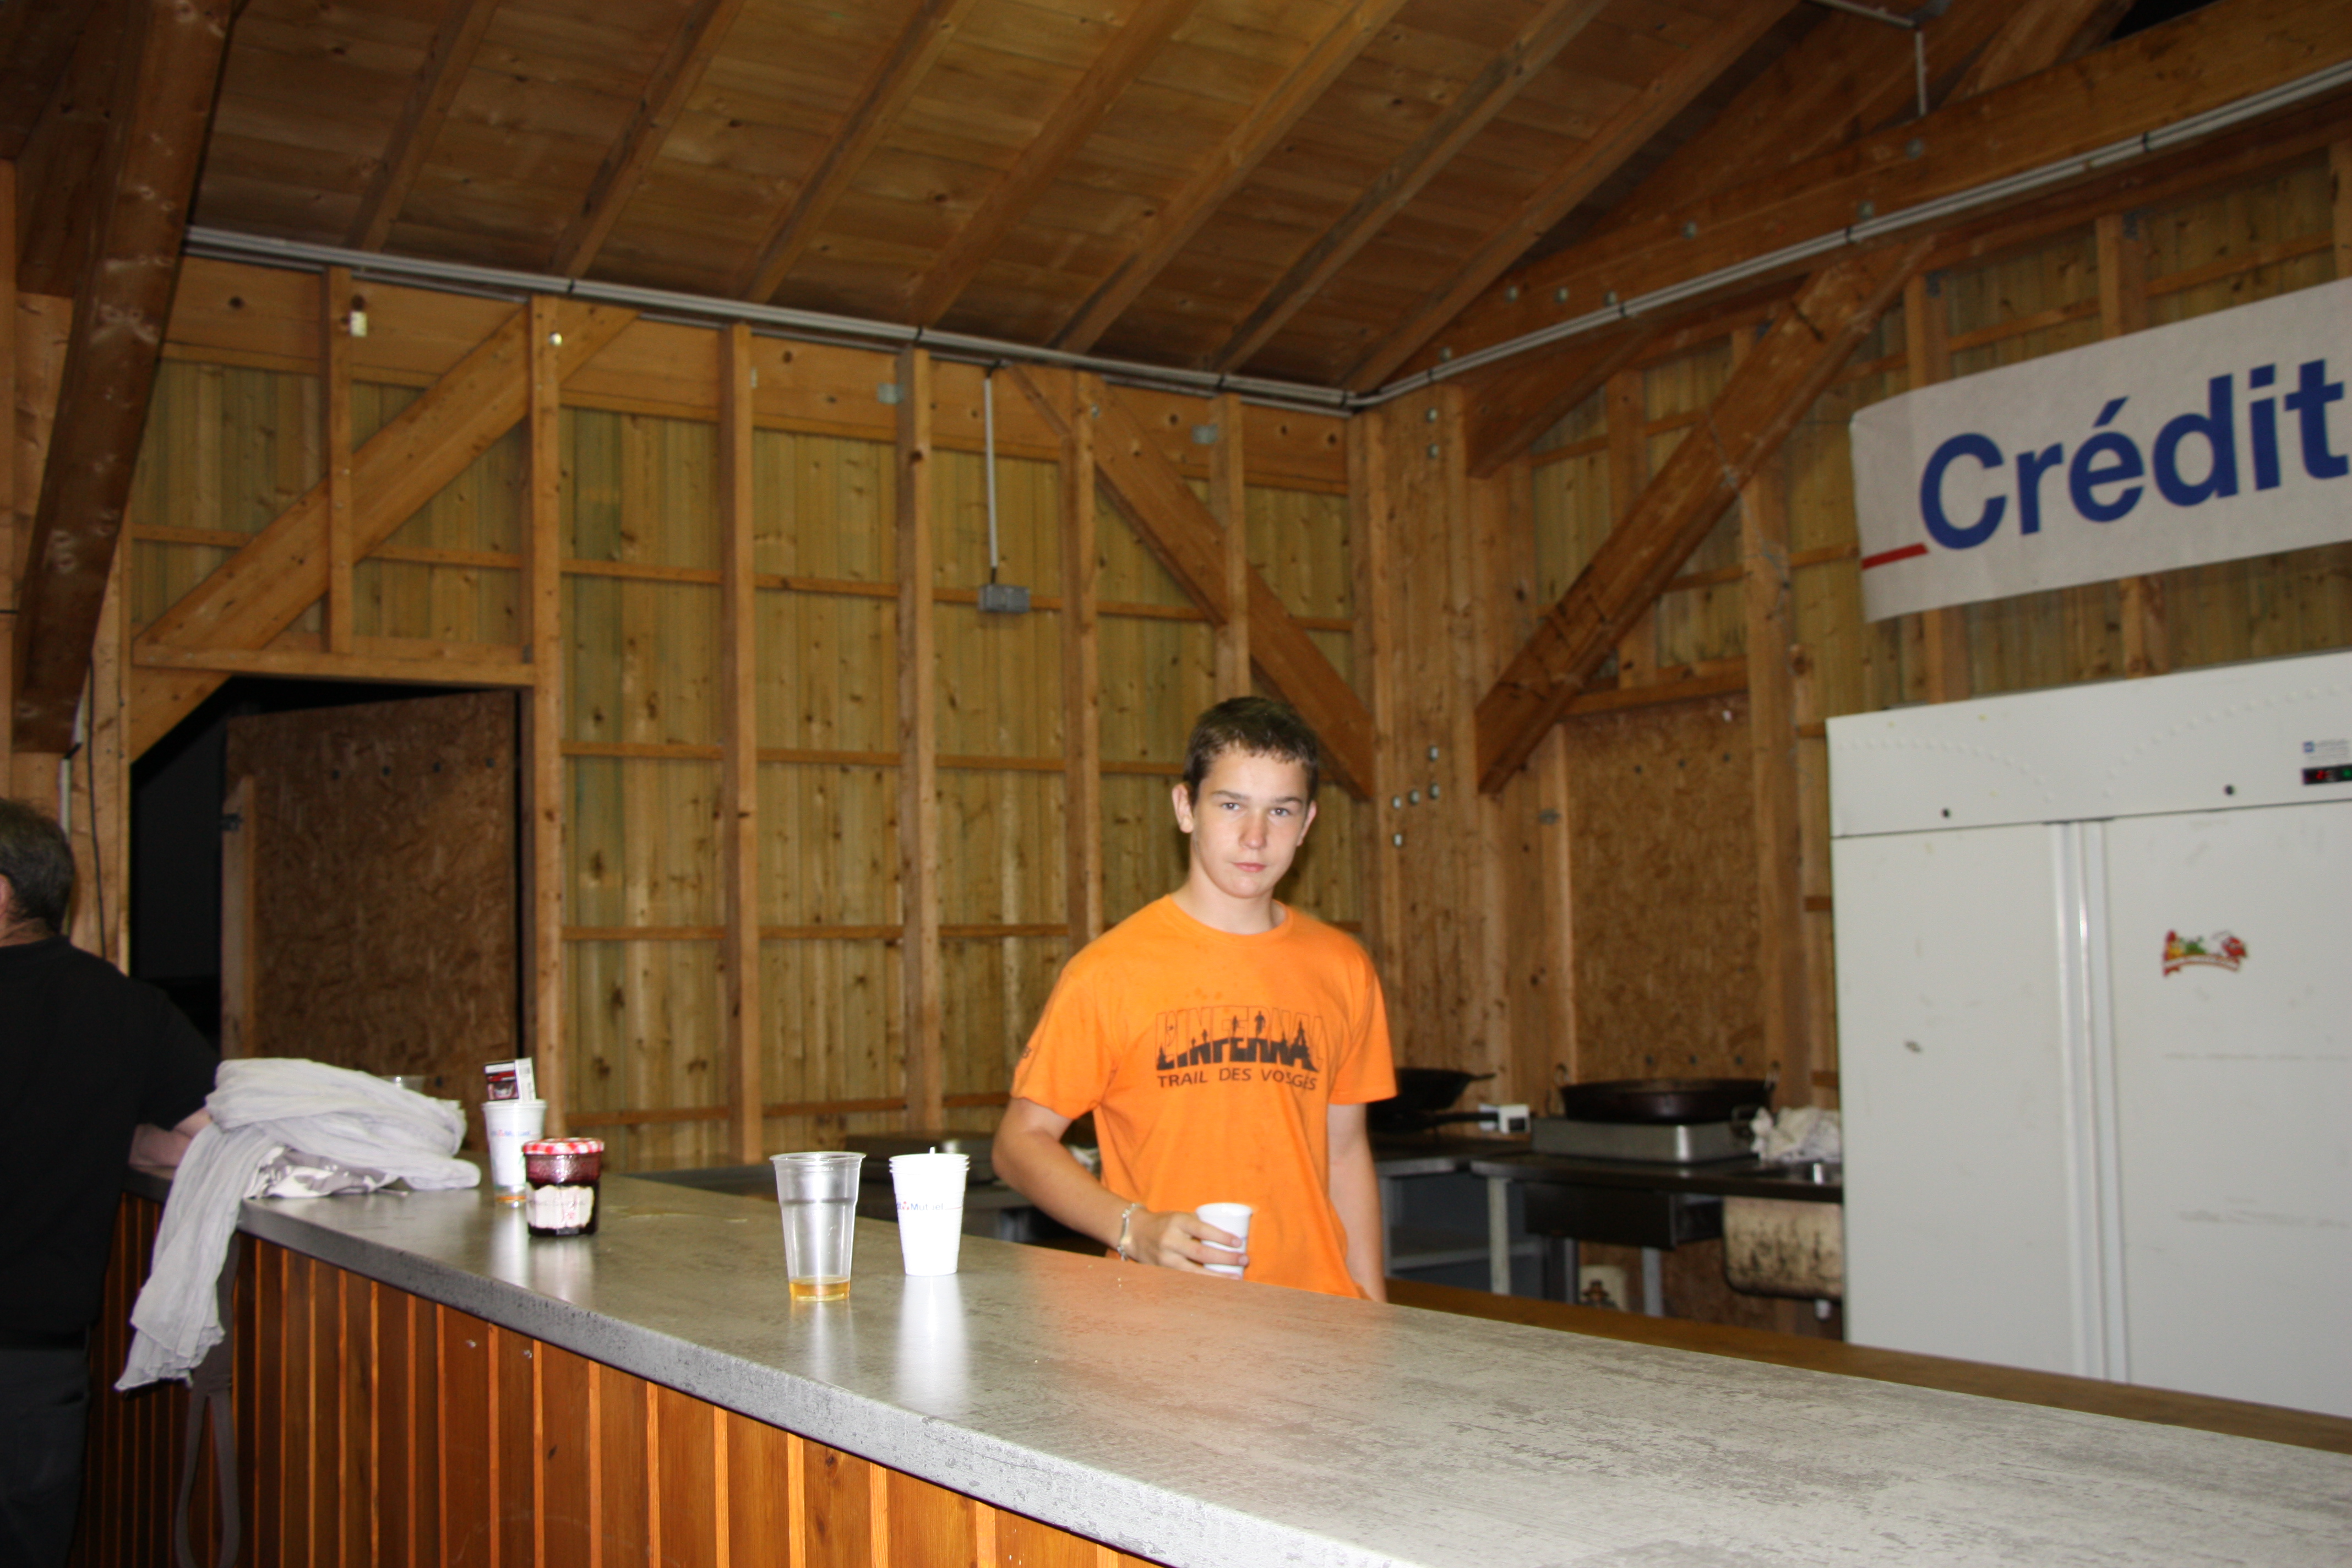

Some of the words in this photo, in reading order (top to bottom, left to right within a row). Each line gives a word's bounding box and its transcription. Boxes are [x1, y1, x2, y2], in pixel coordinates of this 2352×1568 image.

[1921, 360, 2349, 549] Crédit
[1157, 1070, 1208, 1088] TRAIL
[1219, 1068, 1251, 1081] DES
[1261, 1069, 1317, 1090] VOSGES
